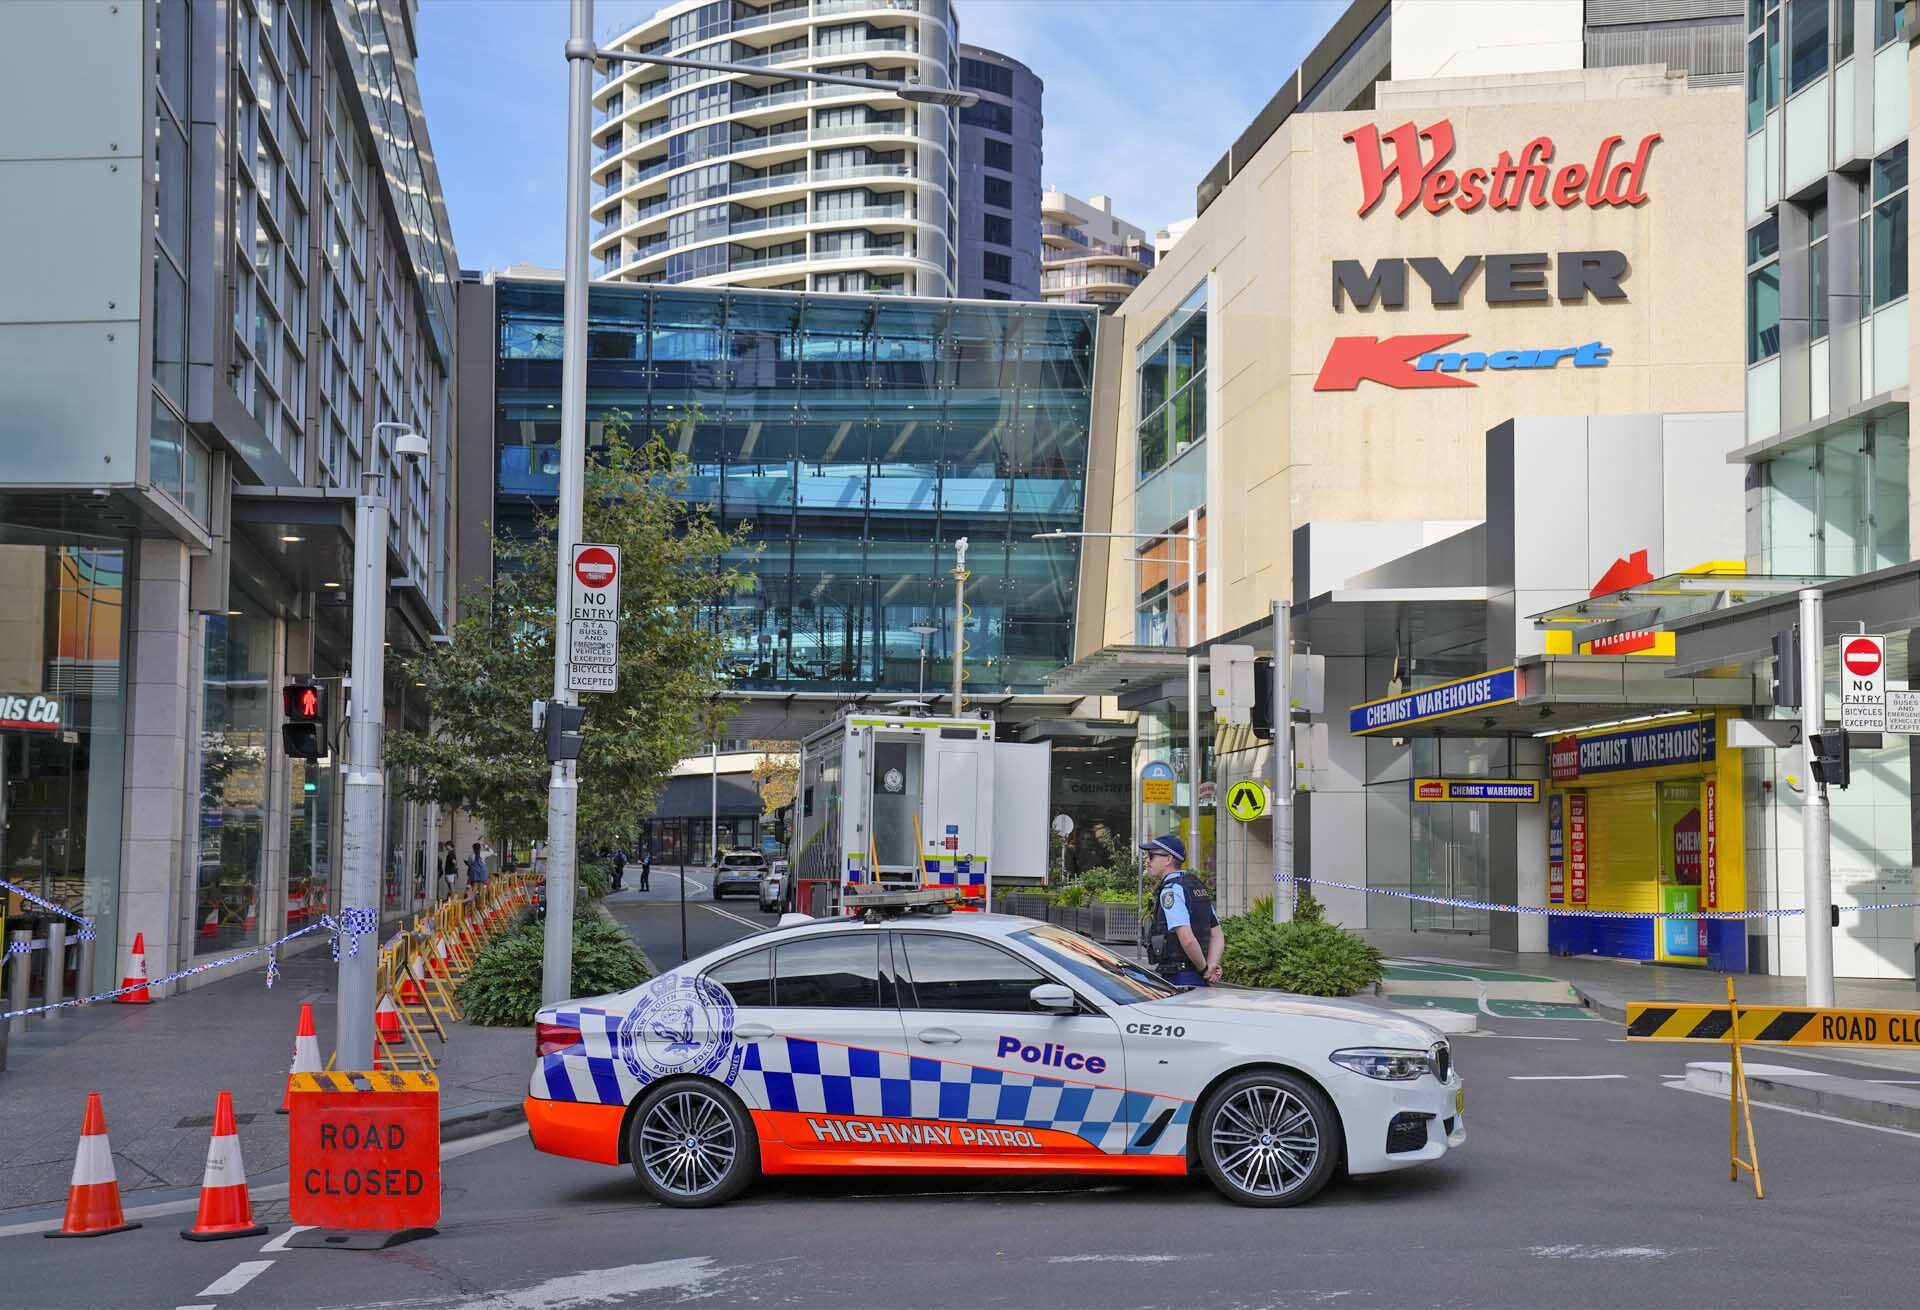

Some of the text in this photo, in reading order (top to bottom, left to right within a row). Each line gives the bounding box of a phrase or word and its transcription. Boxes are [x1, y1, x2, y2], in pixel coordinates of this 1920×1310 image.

[1343, 118, 1661, 218] Westfield
[1332, 250, 1628, 309] MYER
[1313, 333, 1613, 392] Kmart
[584, 593, 606, 605] NO
[574, 608, 614, 619] ENTRY
[572, 665, 614, 674] BICYCLES
[571, 676, 614, 686] EXCEPTED
[1853, 680, 1873, 691] NO
[28, 696, 60, 722] Co.
[1366, 678, 1492, 727] CHEMIST WAREHOUSE
[1845, 695, 1881, 703] ENTRY
[1844, 708, 1883, 716] BICYCLES
[1844, 719, 1884, 727] EXCEPTED
[1790, 724, 1801, 744] 2
[1552, 751, 1578, 768] CHEMIST
[1579, 738, 1627, 768] CHEMIST
[1451, 786, 1532, 796] CHEMIST WAREHOUSE
[1708, 837, 1715, 853] 7
[636, 1018, 647, 1037] NEW
[650, 994, 677, 1012] SOUTH
[1125, 1022, 1186, 1038] CE210
[1822, 1016, 1877, 1040] ROAD
[653, 1039, 716, 1074] POLICE FORCE
[996, 1035, 1107, 1074] Police
[321, 1123, 406, 1150] ROAD
[807, 1118, 1044, 1148] HIGHWAY PATROL
[304, 1168, 424, 1196] CLOSED
